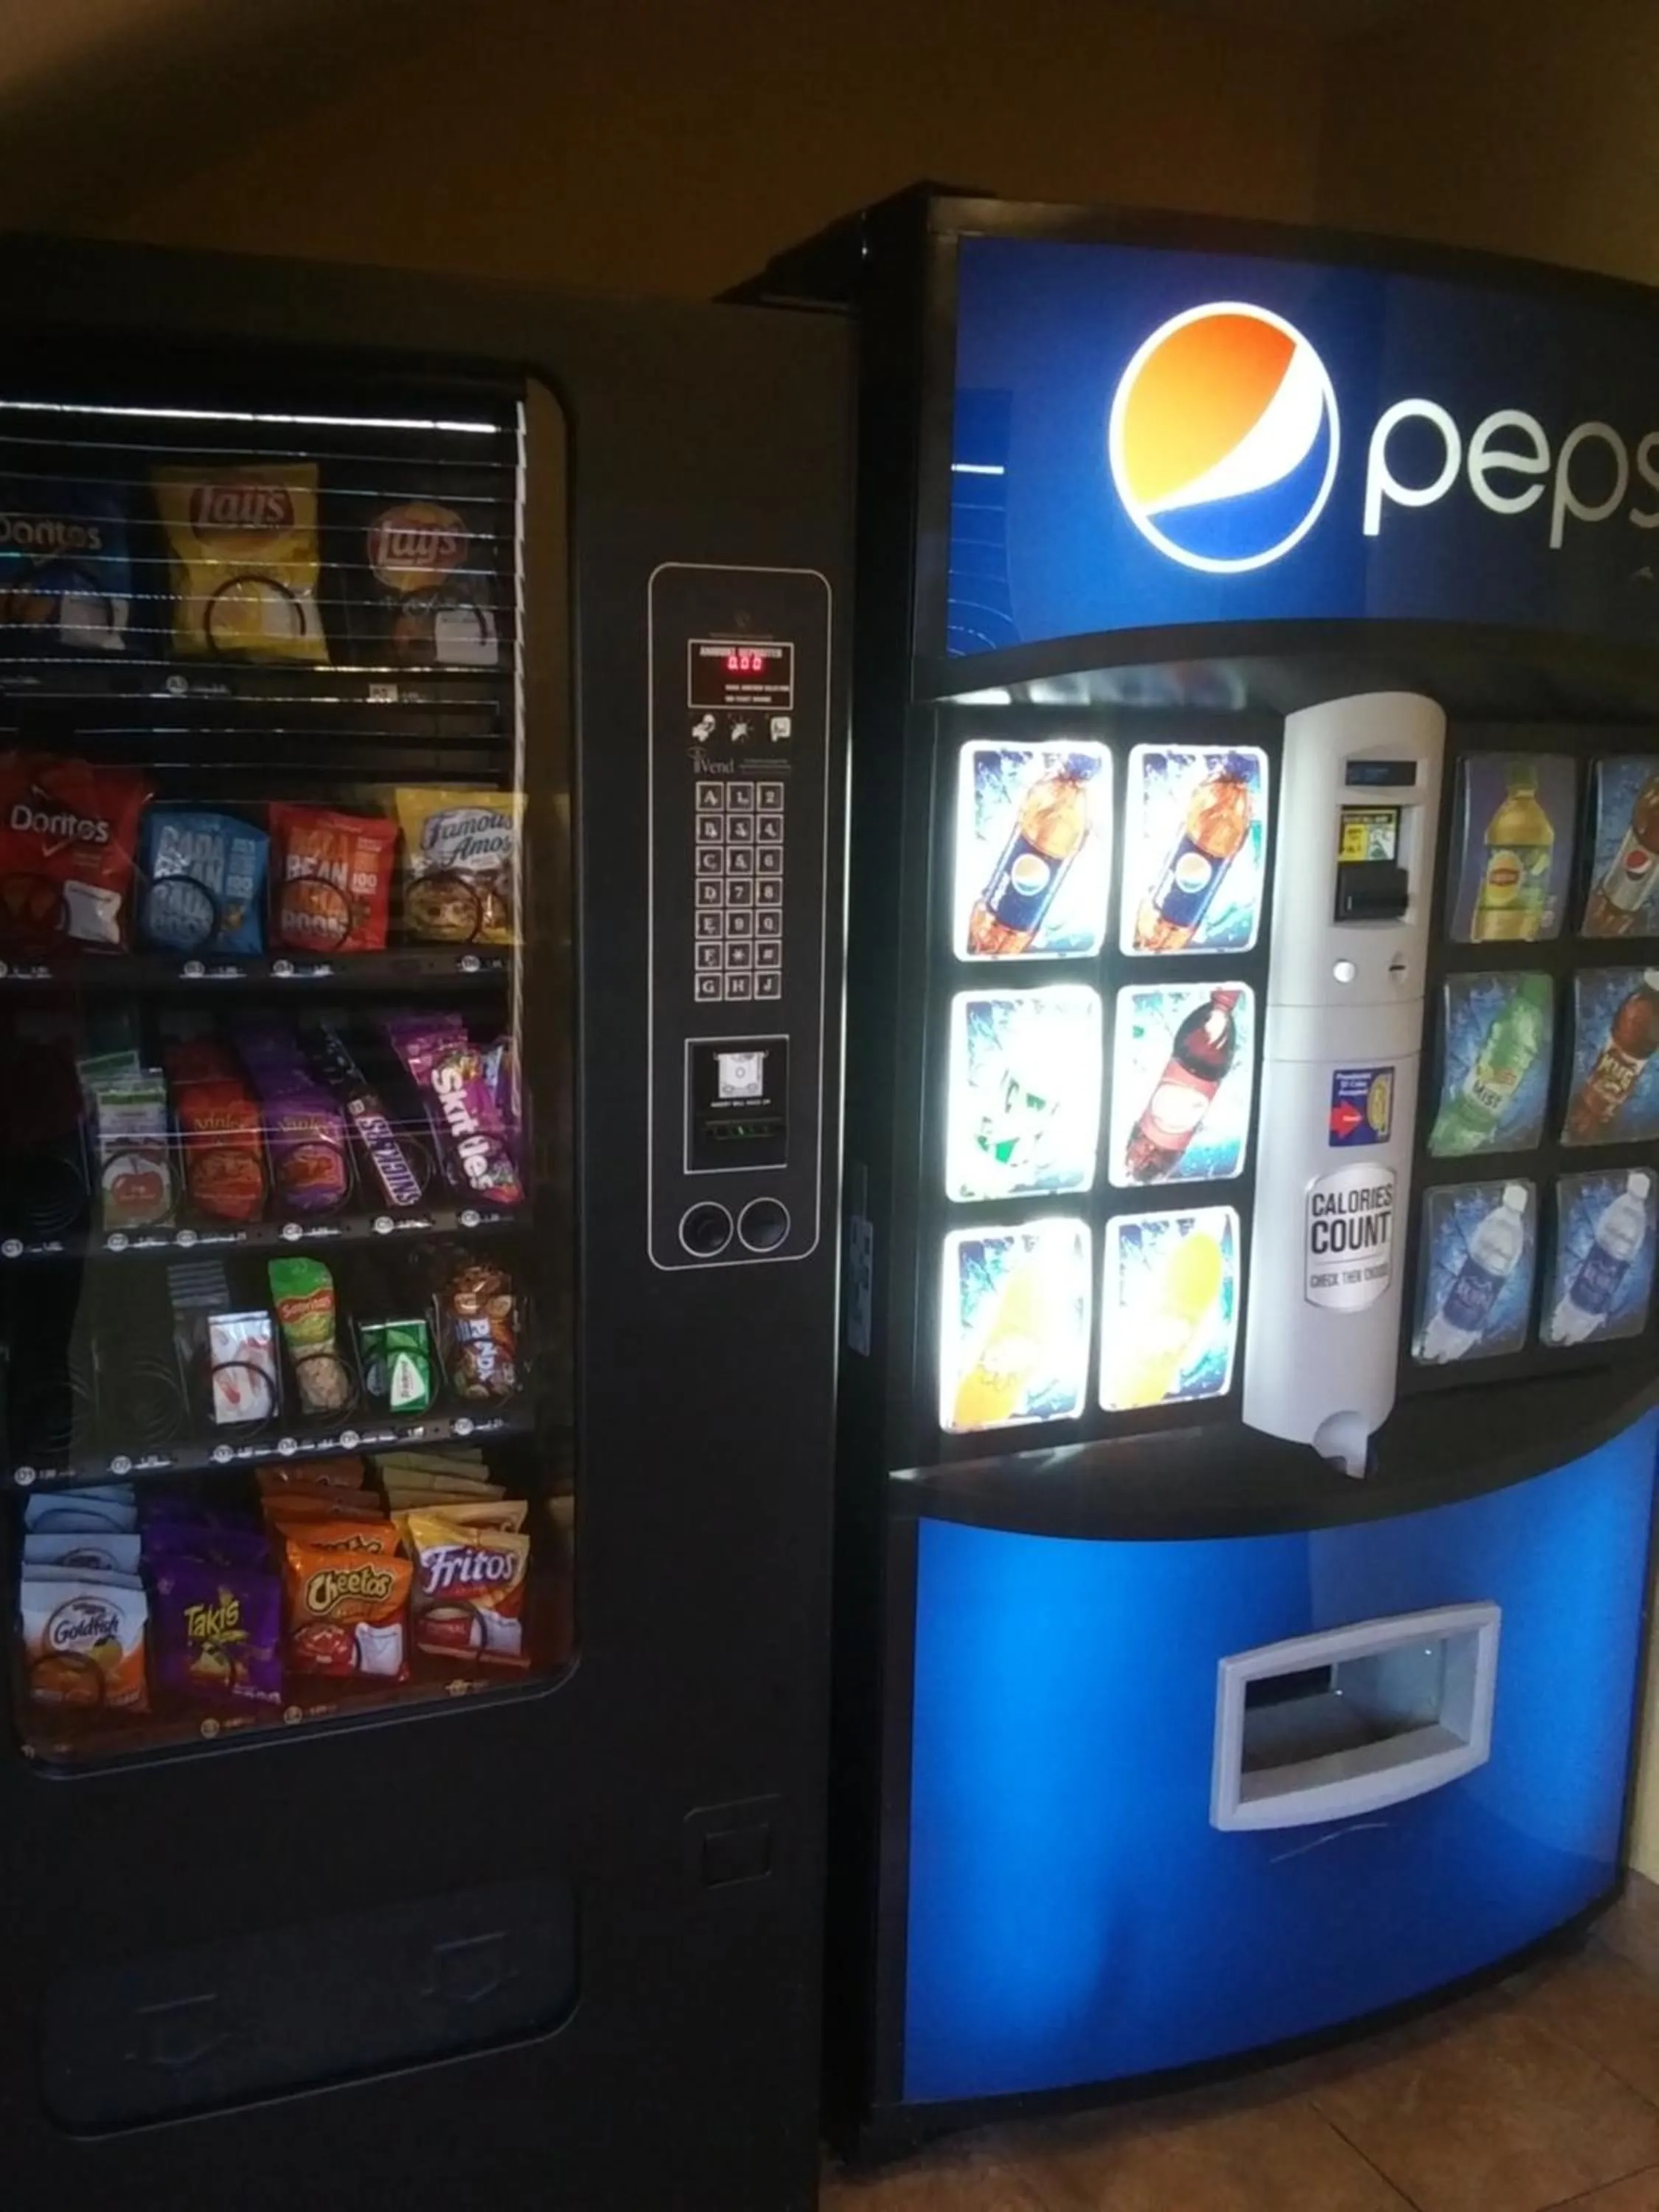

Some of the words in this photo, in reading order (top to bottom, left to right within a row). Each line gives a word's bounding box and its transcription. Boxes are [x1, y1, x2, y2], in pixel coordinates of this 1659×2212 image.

[10, 804, 110, 844] Doritos
[427, 813, 514, 848] Famous
[441, 835, 512, 868] Amos
[356, 1117, 422, 1204] SNICKERS
[1312, 1183, 1393, 1217] CALORIES
[1311, 1211, 1392, 1256] COUNT
[307, 1565, 392, 1614] Cheetos
[422, 1545, 515, 1595] Fritos
[54, 1614, 120, 1645] Goldfish
[183, 1596, 240, 1638] Takis
